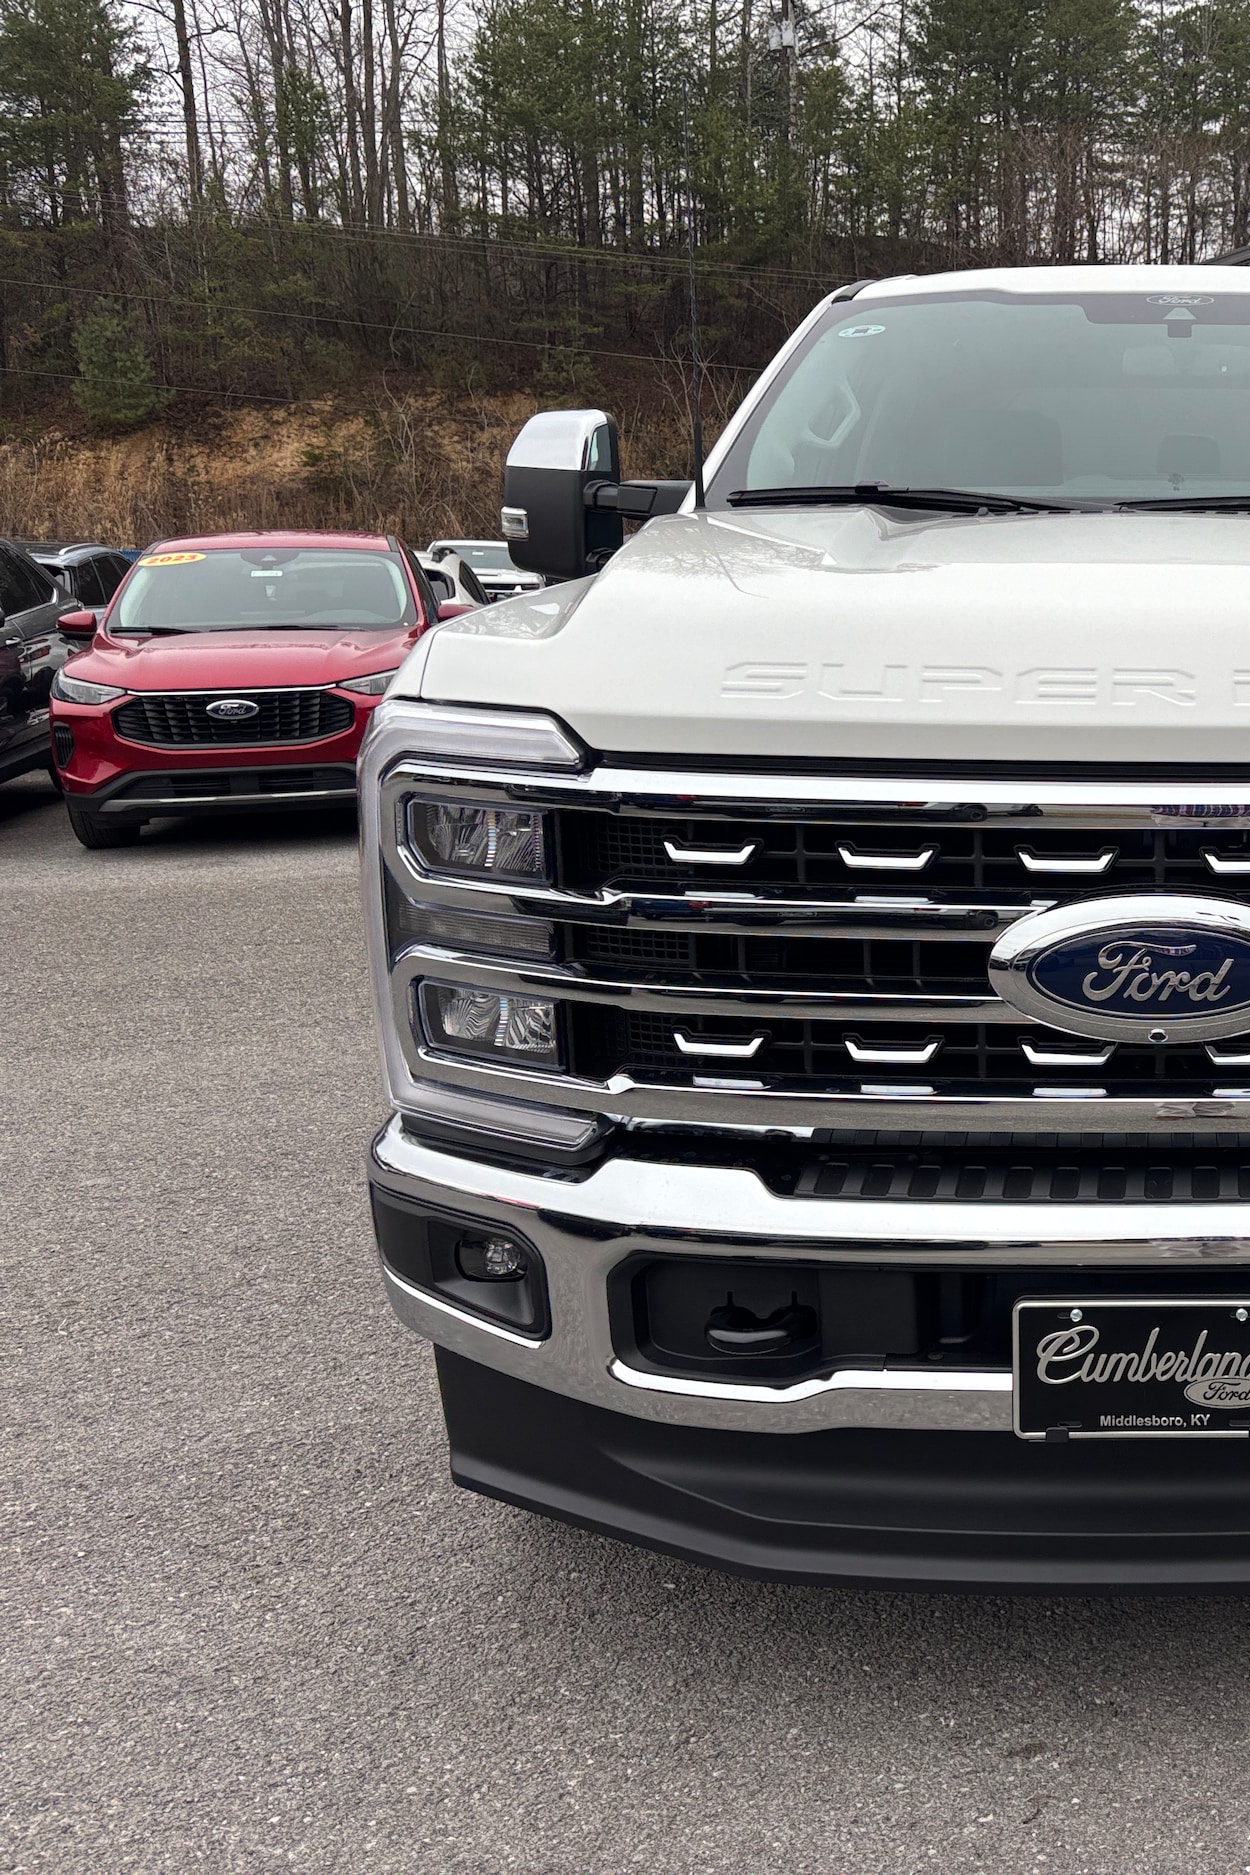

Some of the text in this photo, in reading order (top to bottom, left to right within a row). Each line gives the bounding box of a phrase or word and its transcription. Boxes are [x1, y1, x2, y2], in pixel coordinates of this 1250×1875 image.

[1158, 295, 1202, 304] Ford
[147, 554, 197, 565] 2023
[719, 661, 1197, 706] SUPER
[218, 703, 247, 715] Ford
[1082, 940, 1235, 1002] Ford
[1100, 1414, 1211, 1428] Middlesboro, KY
